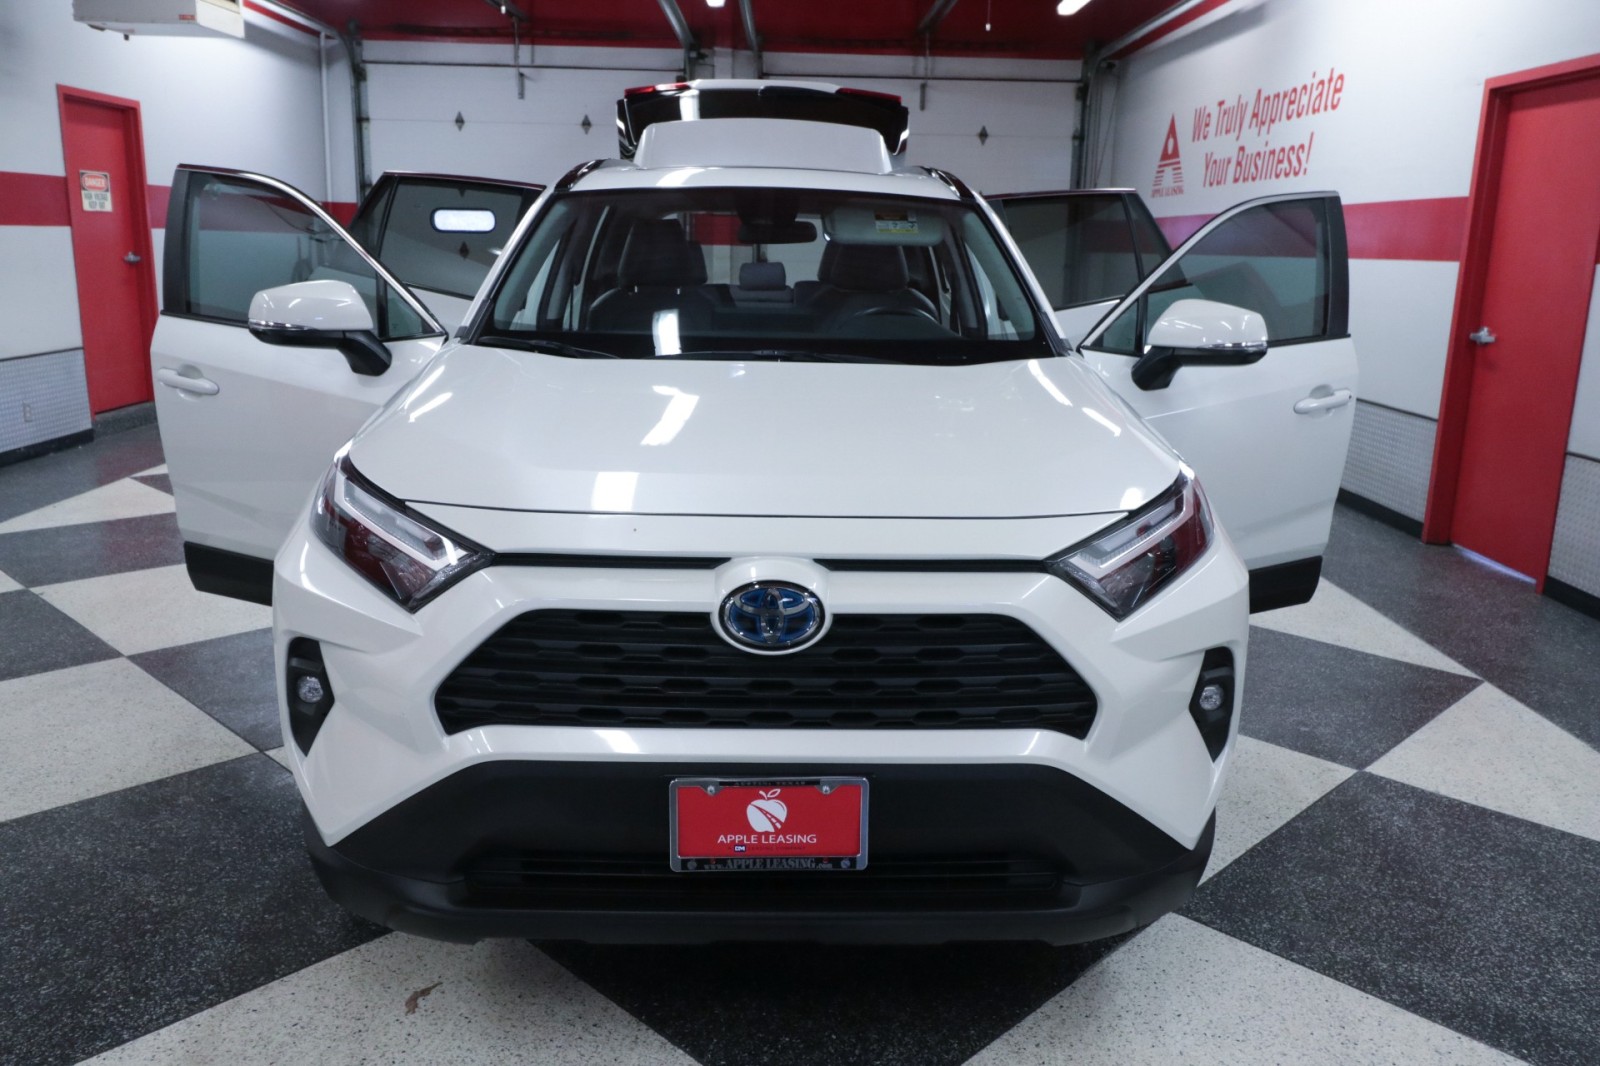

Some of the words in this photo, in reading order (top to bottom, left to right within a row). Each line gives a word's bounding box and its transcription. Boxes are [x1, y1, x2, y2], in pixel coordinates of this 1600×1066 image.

[1192, 106, 1211, 142] We
[1215, 95, 1248, 141] Truly
[1249, 68, 1344, 136] Appreciate
[1203, 152, 1231, 188] Your
[1233, 131, 1314, 184] Business!
[84, 177, 106, 187] DANGER
[717, 834, 758, 844] APPLE
[761, 834, 817, 844] LEASING
